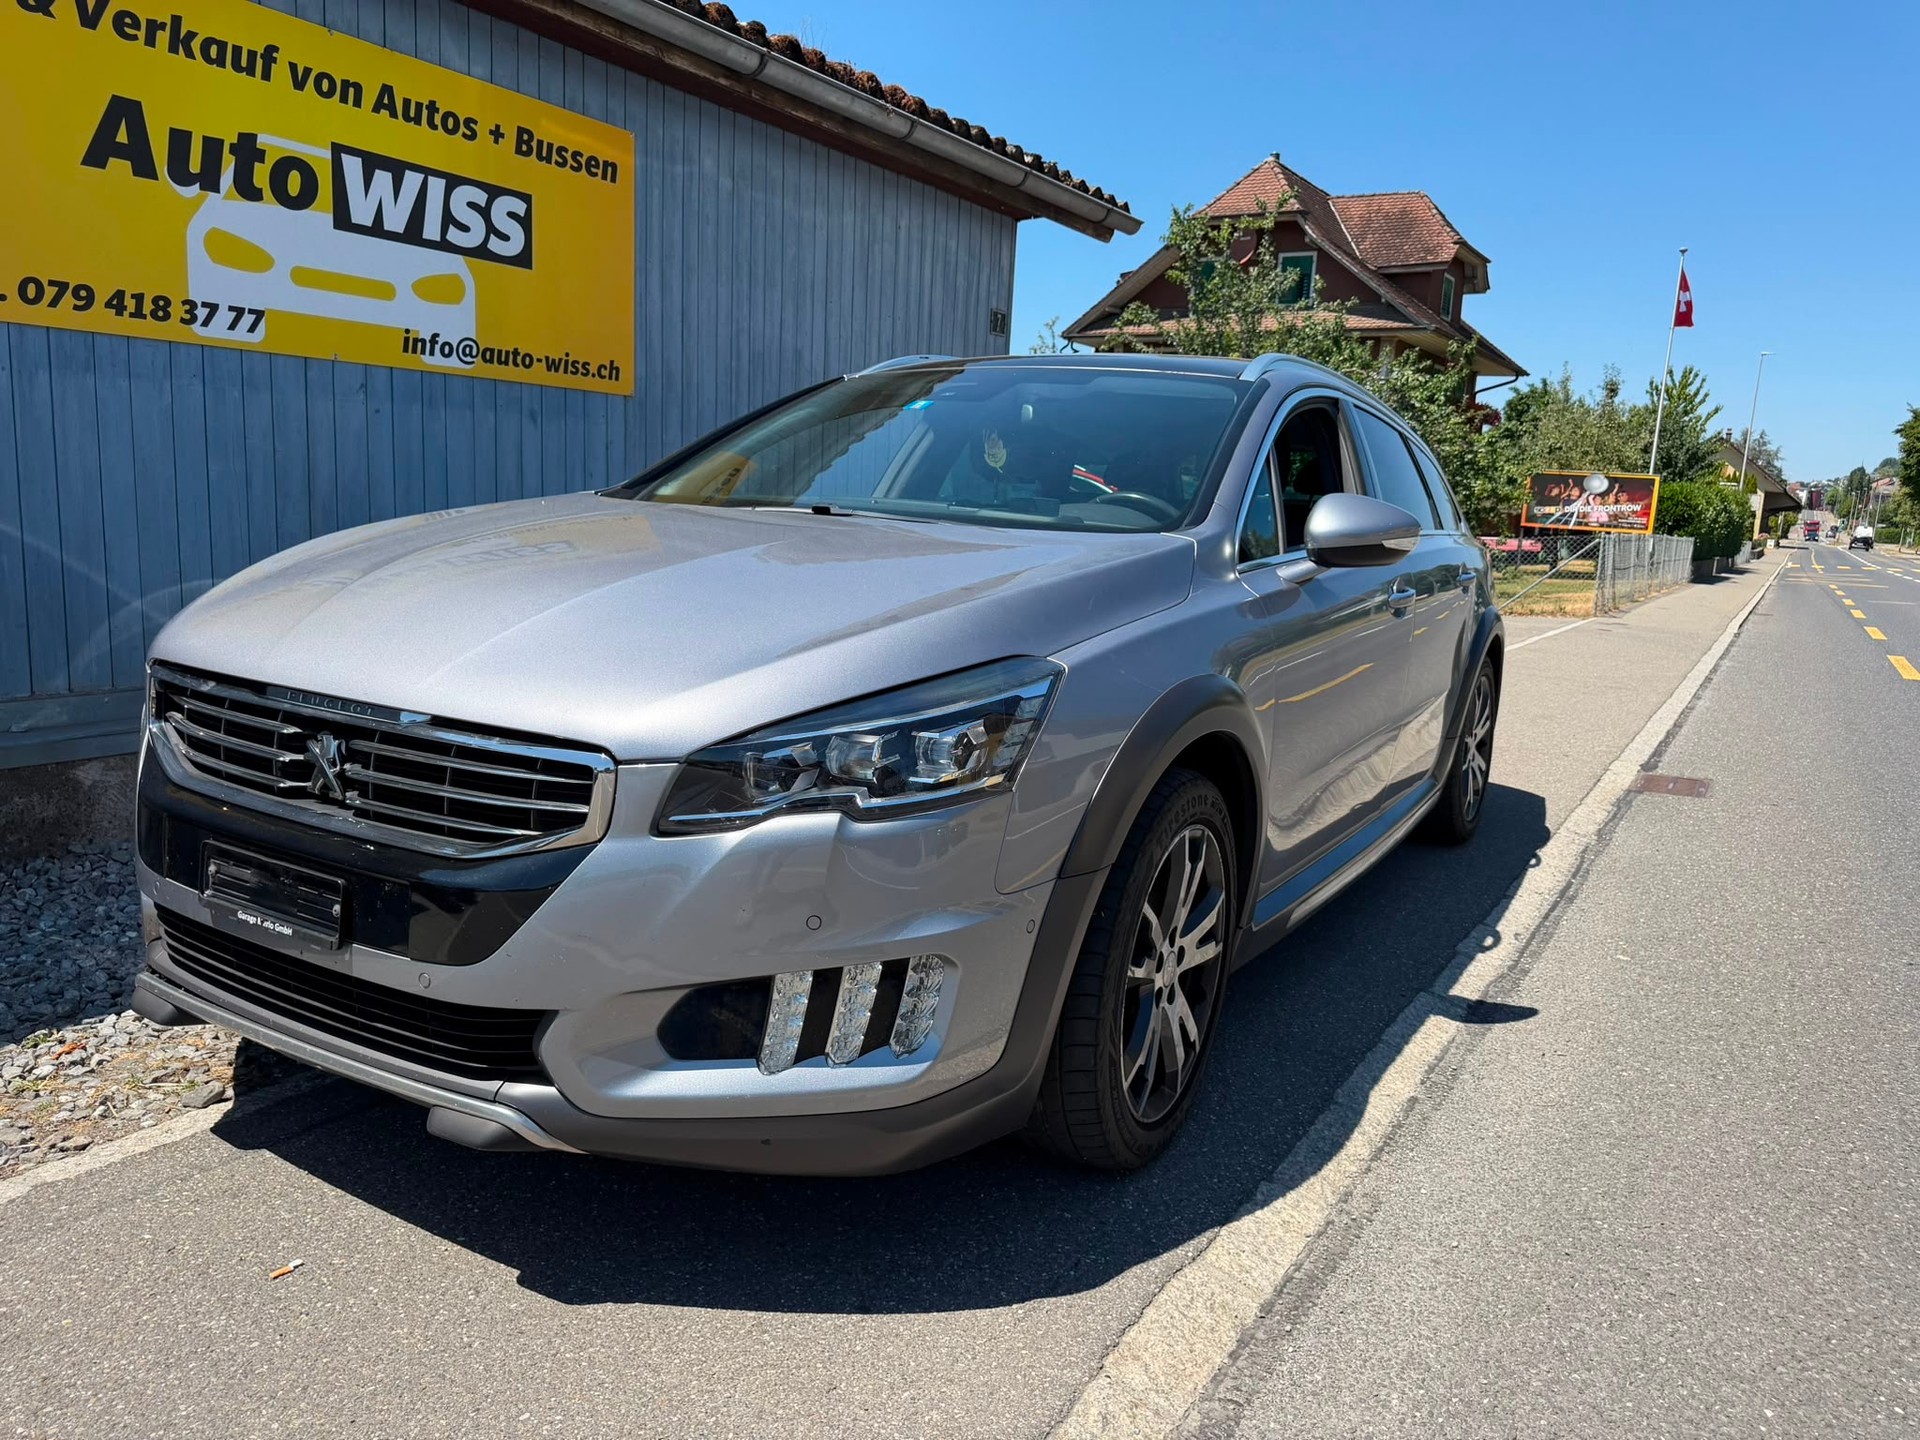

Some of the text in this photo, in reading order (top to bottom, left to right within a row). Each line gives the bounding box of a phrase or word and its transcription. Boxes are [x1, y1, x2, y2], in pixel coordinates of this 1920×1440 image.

[75, 0, 618, 183] Verkauf von Autos + Bussen
[80, 94, 528, 257] Auto WISS
[17, 276, 266, 334] 079 418 37 77
[402, 329, 621, 382] info@auto-wiss.ch
[237, 910, 257, 925] Garage
[274, 922, 293, 936] GmbH
